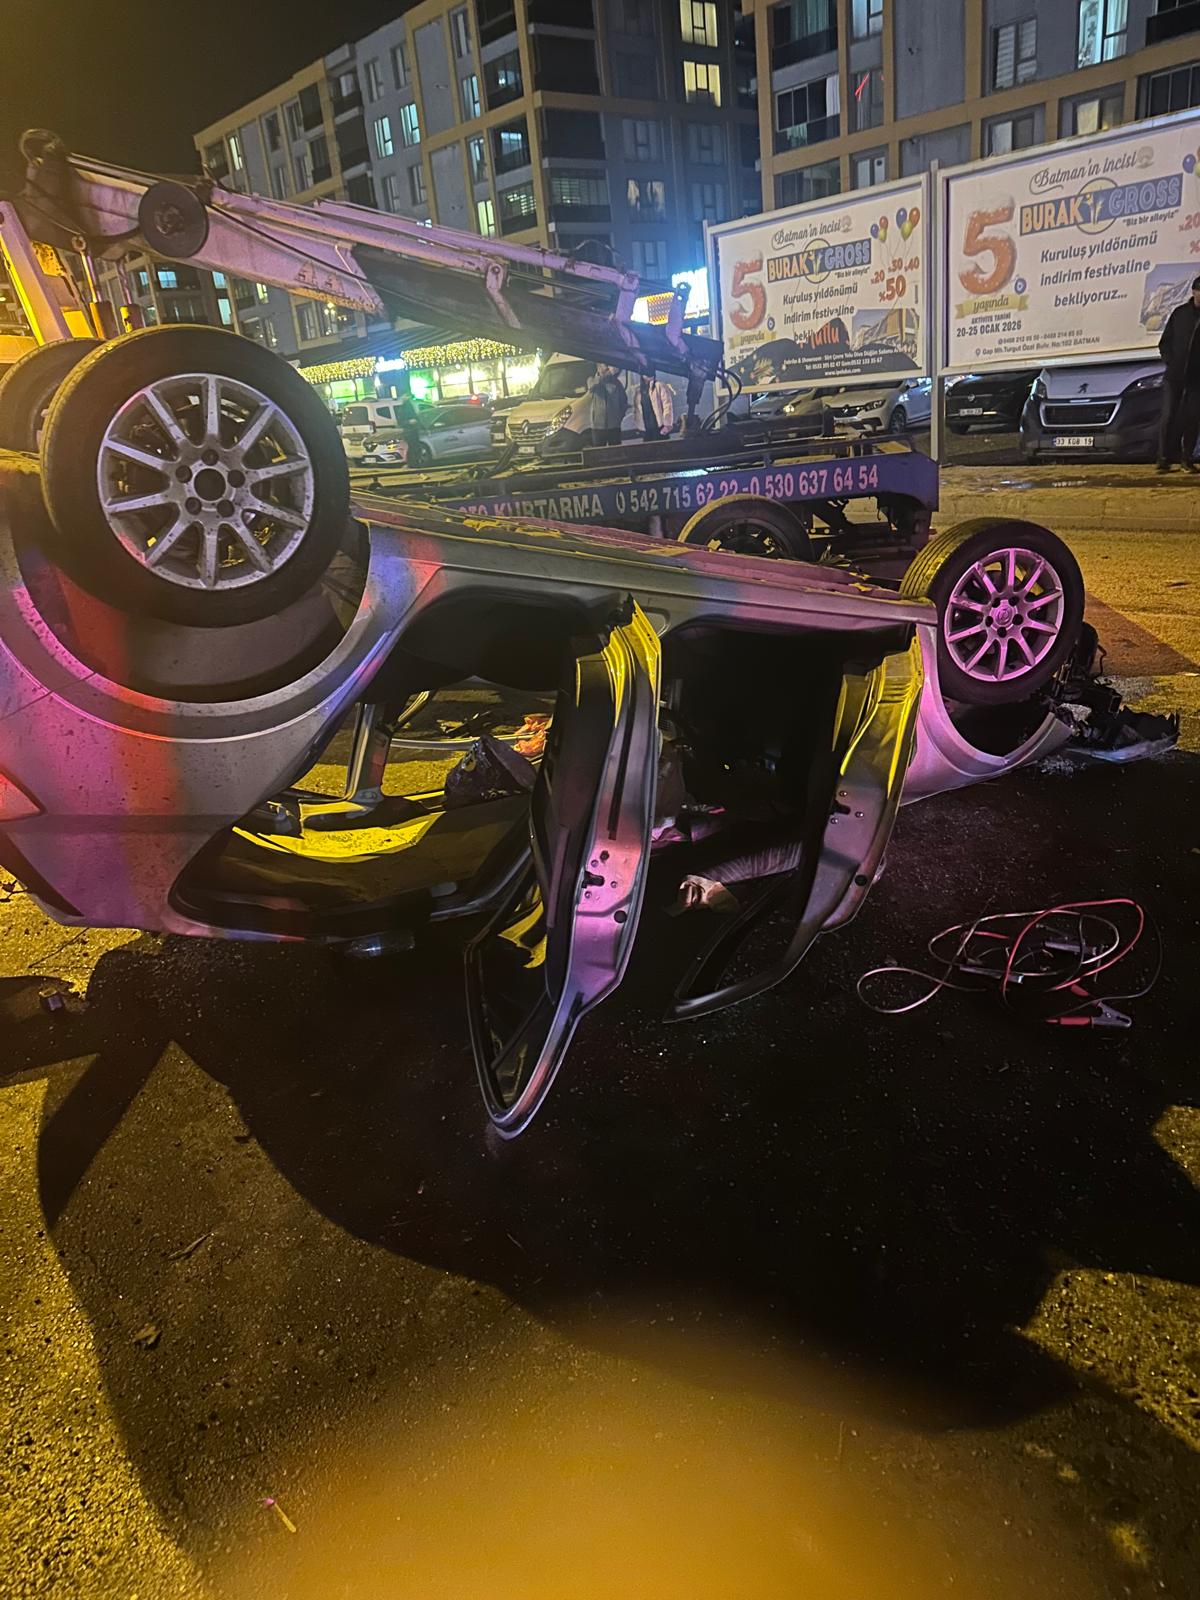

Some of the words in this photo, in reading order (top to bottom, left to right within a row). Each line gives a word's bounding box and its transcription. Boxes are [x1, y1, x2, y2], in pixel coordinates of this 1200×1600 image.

[1022, 194, 1083, 234] BURAK
[1108, 176, 1180, 217] GROSS
[959, 194, 1017, 295] 5
[1040, 246, 1086, 264] Kuruluş
[1088, 231, 1158, 258] yıldönümü
[768, 252, 810, 281] BURAK
[824, 240, 870, 270] GROSS
[1084, 259, 1151, 280] festivaline
[730, 250, 767, 330] 5
[783, 292, 813, 306] Kuruluş
[814, 282, 858, 302] yıldönümü
[879, 275, 906, 303] %50
[1054, 289, 1128, 307] bekliyoruz...
[973, 295, 1010, 313] yaşında
[956, 325, 978, 338] 20-25
[980, 323, 1000, 335] OCAK
[1002, 320, 1022, 332] 2026
[1073, 336, 1100, 346] BATMAN
[494, 494, 604, 519] KURTARMA
[630, 488, 658, 511] 542
[663, 485, 691, 508] 715
[696, 483, 714, 504] 62
[765, 473, 794, 499] 530
[799, 471, 828, 495] 637
[834, 466, 853, 492] 64
[859, 464, 878, 490] 54
